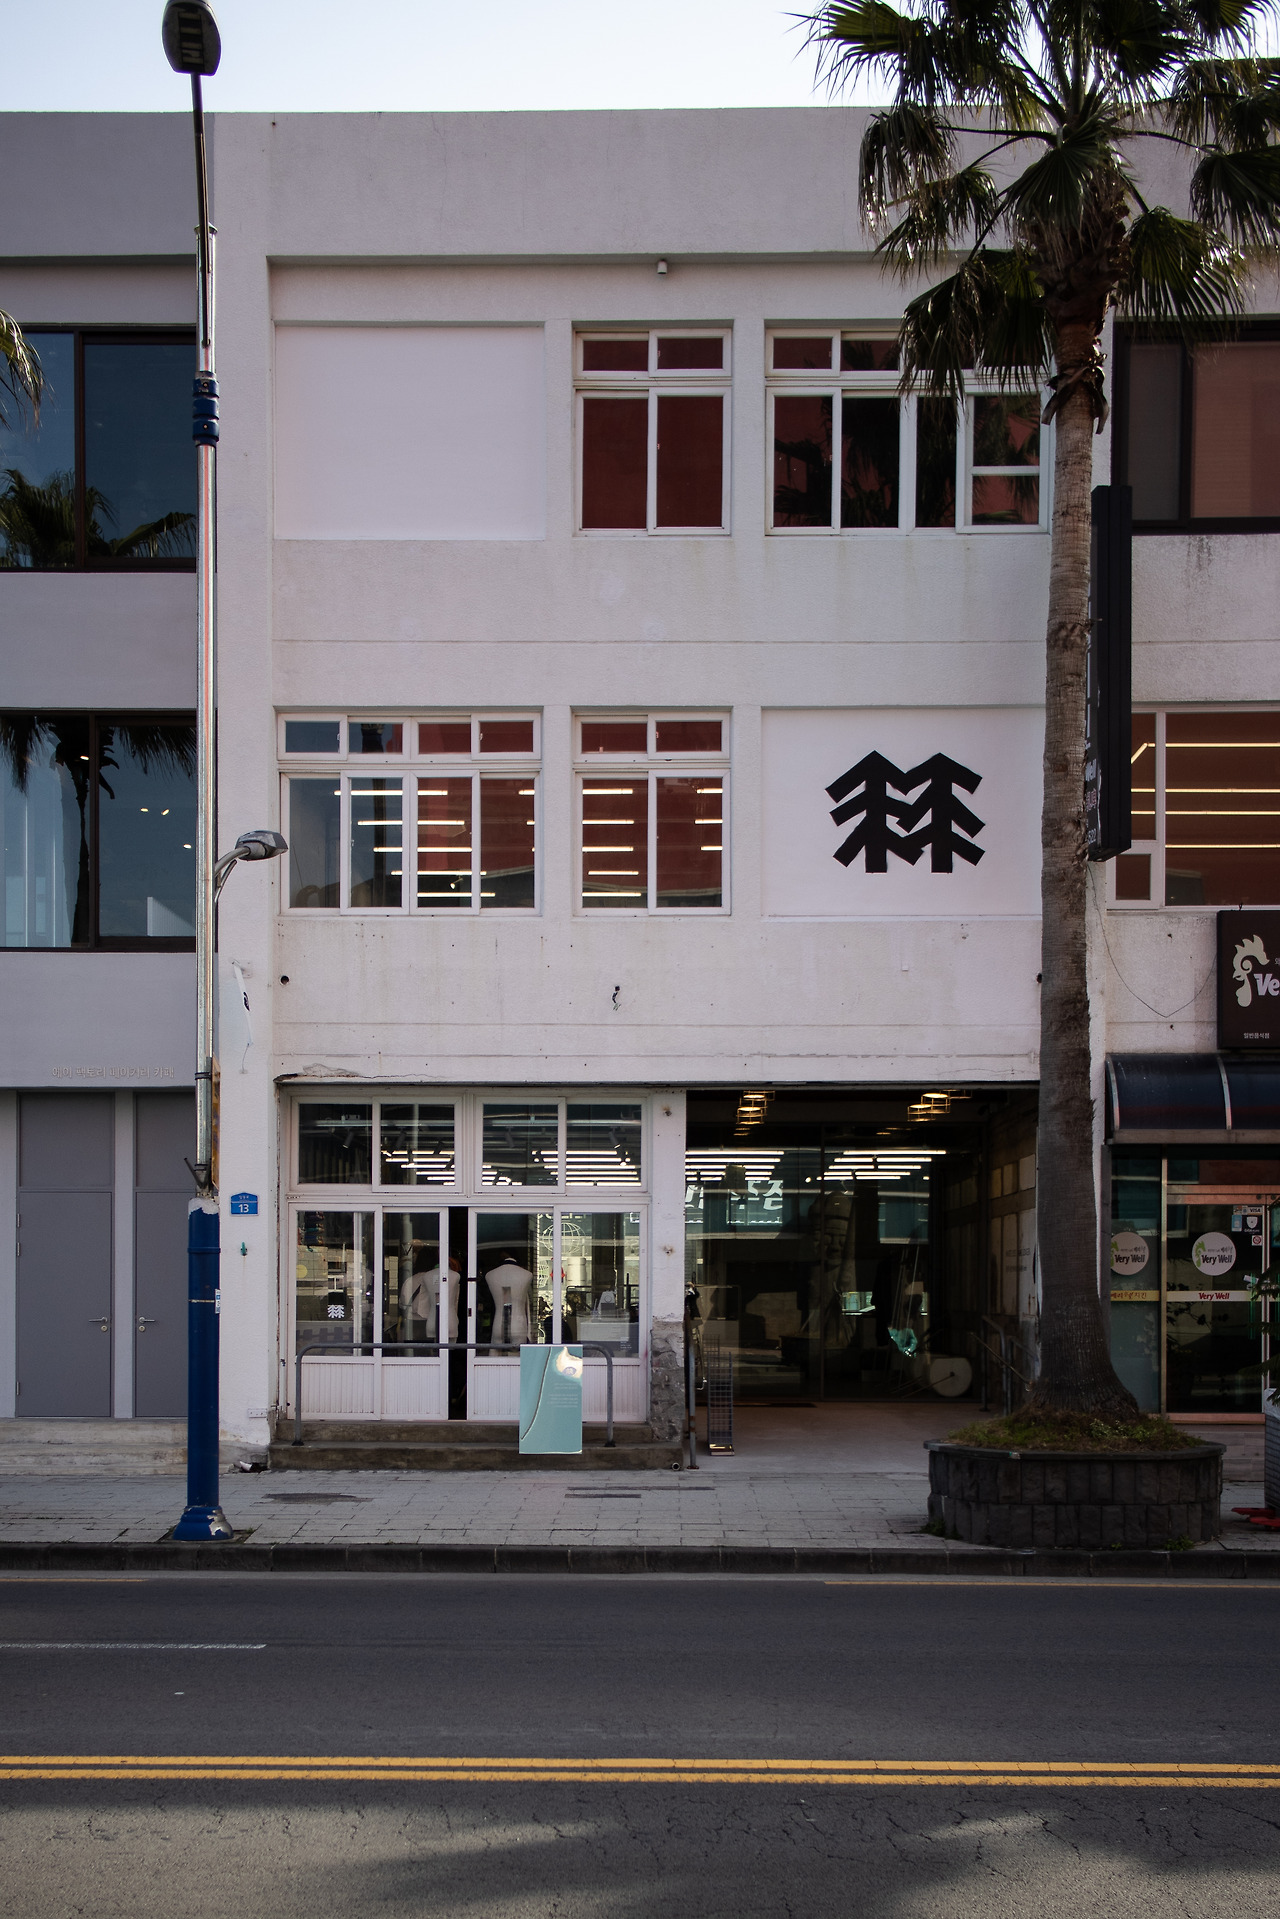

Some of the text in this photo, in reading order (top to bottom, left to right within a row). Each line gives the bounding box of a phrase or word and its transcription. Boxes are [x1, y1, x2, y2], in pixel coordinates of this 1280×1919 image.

[52, 1066, 174, 1079] 에이 팩토리 베이커리 카페
[238, 1203, 249, 1213] 13
[1114, 1254, 1146, 1264] Very Well
[1201, 1254, 1233, 1265] Very Well
[1198, 1292, 1214, 1301] Very
